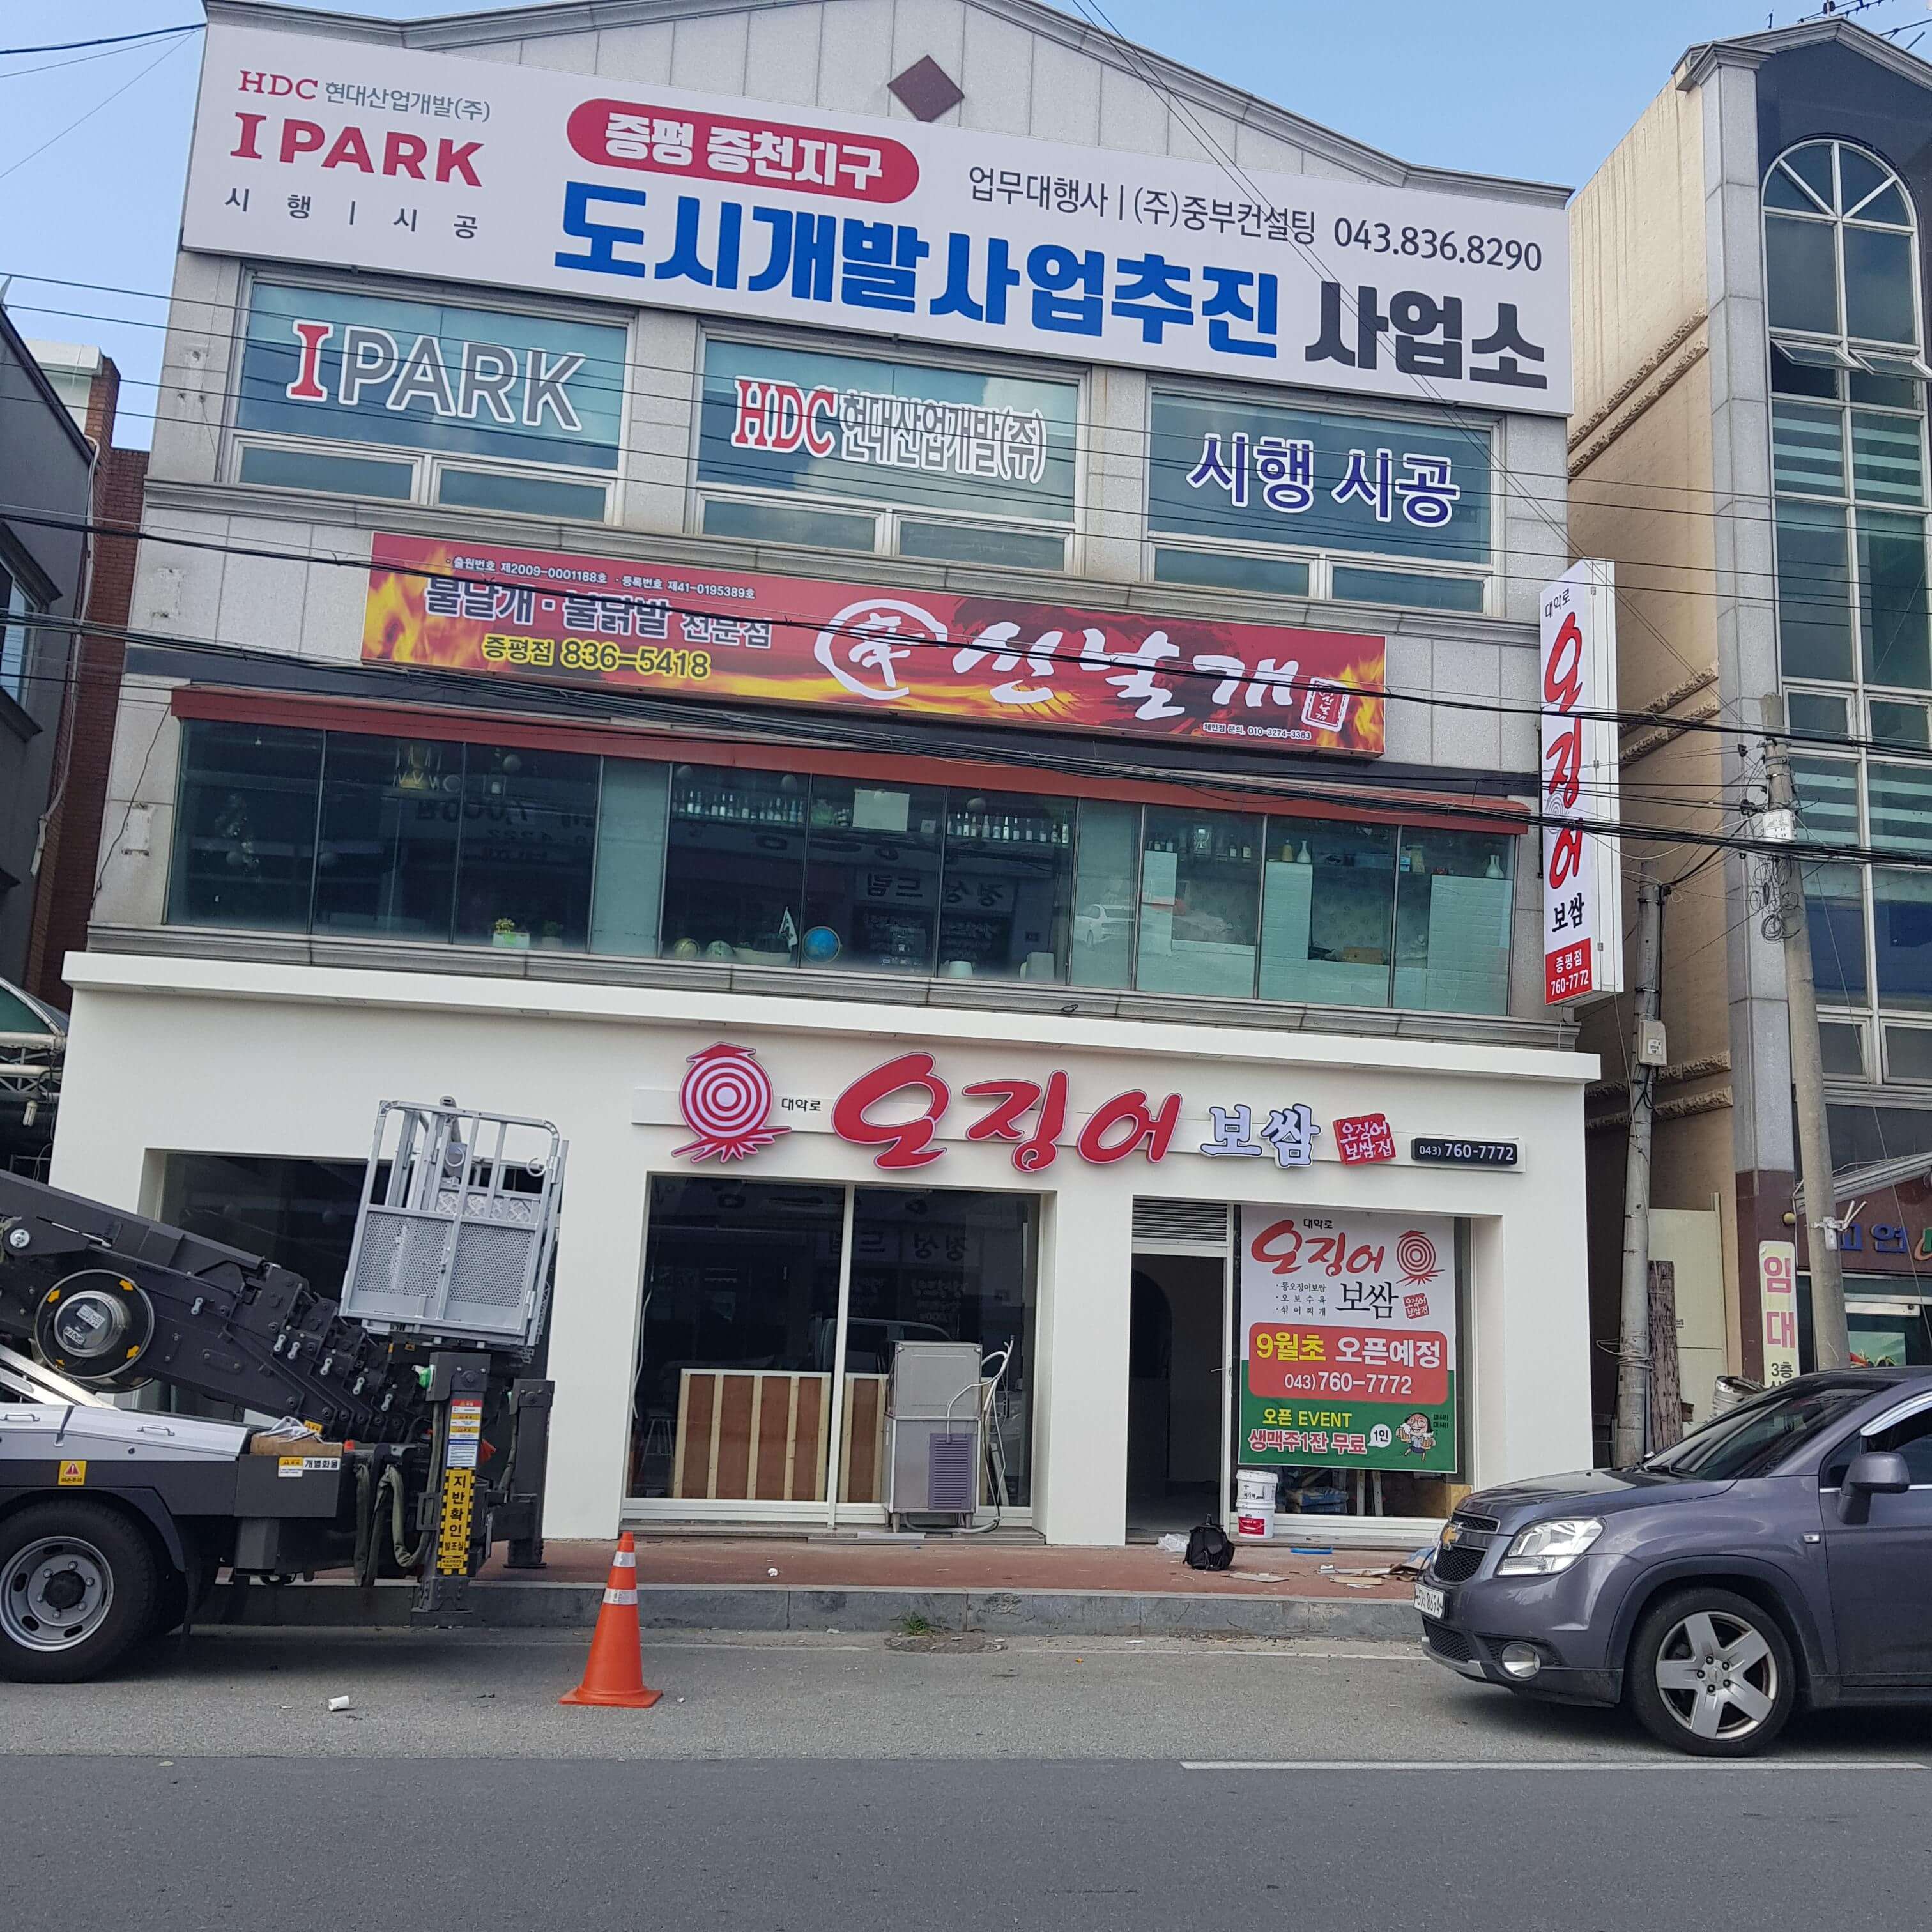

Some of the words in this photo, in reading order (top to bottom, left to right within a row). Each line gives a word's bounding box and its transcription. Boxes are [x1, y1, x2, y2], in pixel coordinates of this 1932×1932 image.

[238, 70, 318, 100] HDC
[325, 80, 491, 123] 현대산업개발(주)
[605, 112, 693, 166] 증평
[706, 126, 882, 190] 증천지구
[1334, 216, 1543, 272] 043.836.8290
[555, 180, 1278, 359] 도시개발사업추진
[1305, 281, 1548, 390] 사업소
[286, 319, 586, 432] IPARK
[731, 376, 838, 458] HDC
[839, 388, 1047, 484] 현대산업개발(주)
[1186, 431, 1314, 514] 시행
[1331, 448, 1460, 528] 시공
[680, 613, 772, 649] 전문점
[482, 634, 555, 667] 증평점
[560, 638, 711, 680] 836-5418
[952, 622, 1300, 721] 신날개
[1248, 726, 1312, 740] 010-3274-3383
[1551, 892, 1585, 933] 보쌈
[1555, 949, 1583, 974] 증평점
[1550, 969, 1589, 996] 760-7772
[781, 1098, 822, 1113] 대학로
[831, 1051, 1183, 1173] 오징어
[1199, 1103, 1322, 1169] 보쌈
[1340, 1119, 1390, 1144] 오징어
[1345, 1138, 1393, 1162] 보쌈집
[1303, 1218, 1333, 1230] 대학로
[1251, 1219, 1384, 1277] 오징어
[1335, 1280, 1399, 1320] 보쌈
[1763, 1256, 1795, 1349] 임대
[1255, 1331, 1327, 1362] 9월초
[1335, 1336, 1441, 1369] 오픈예정
[1771, 1361, 1793, 1379] 3층
[1262, 1408, 1293, 1426] 오픈
[1298, 1410, 1353, 1428] EVENT
[1373, 1430, 1389, 1443] 1인
[1248, 1428, 1328, 1453] 생맥주1잔
[1330, 1434, 1368, 1455] 무료
[305, 1460, 338, 1468] 개별화물
